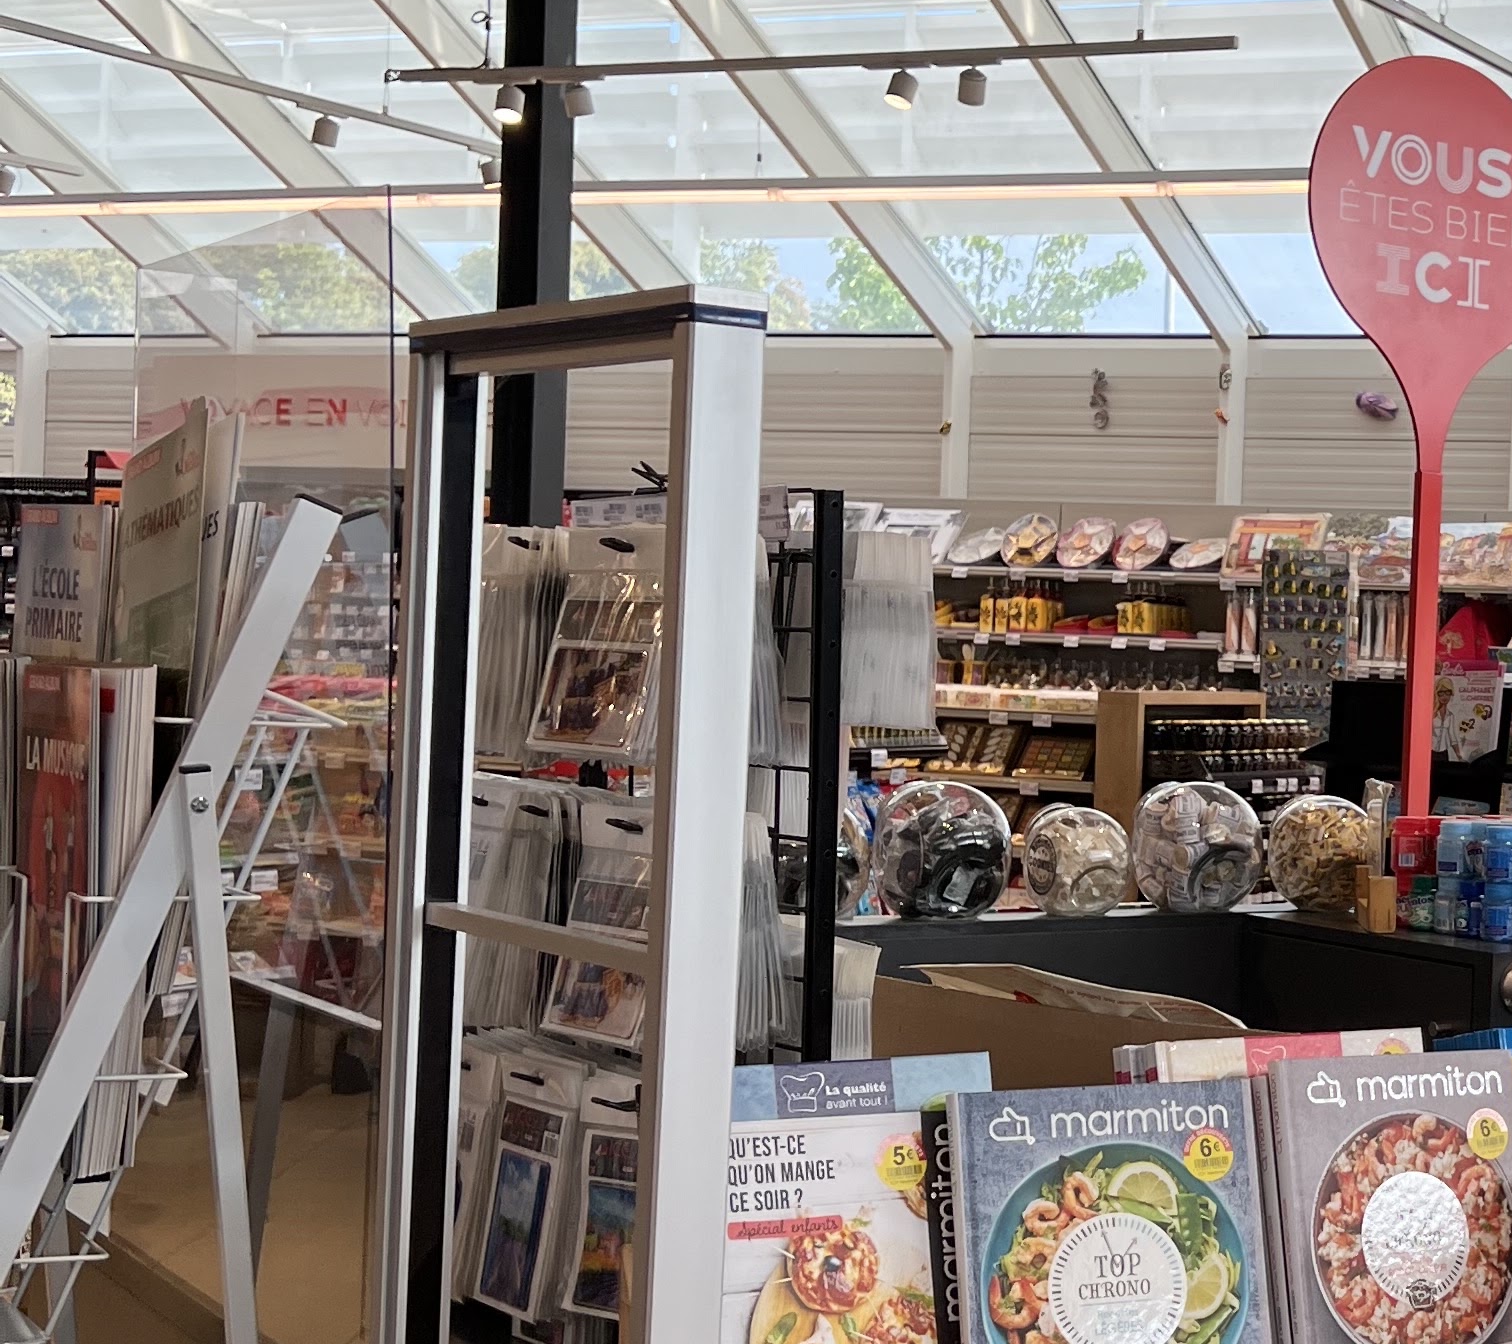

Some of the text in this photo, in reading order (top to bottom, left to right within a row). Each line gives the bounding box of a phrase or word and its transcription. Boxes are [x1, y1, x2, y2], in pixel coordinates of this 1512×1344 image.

[1338, 179, 1434, 235] ÊTES
[1375, 242, 1491, 310] ICI
[24, 608, 84, 643] PRIMAIRE
[824, 1081, 887, 1099] La qualité
[1356, 1066, 1503, 1103] marmiton
[825, 1095, 882, 1110] avant tout
[1050, 1100, 1229, 1139] marmiton
[728, 1134, 806, 1160] QU'EST-CE
[728, 1159, 836, 1187] QU'ON MANGE
[729, 1189, 791, 1213] CE SOIR
[737, 1217, 840, 1240] Spécial enfants
[1093, 1251, 1142, 1278] TOP
[1077, 1279, 1151, 1301] CHRONO
